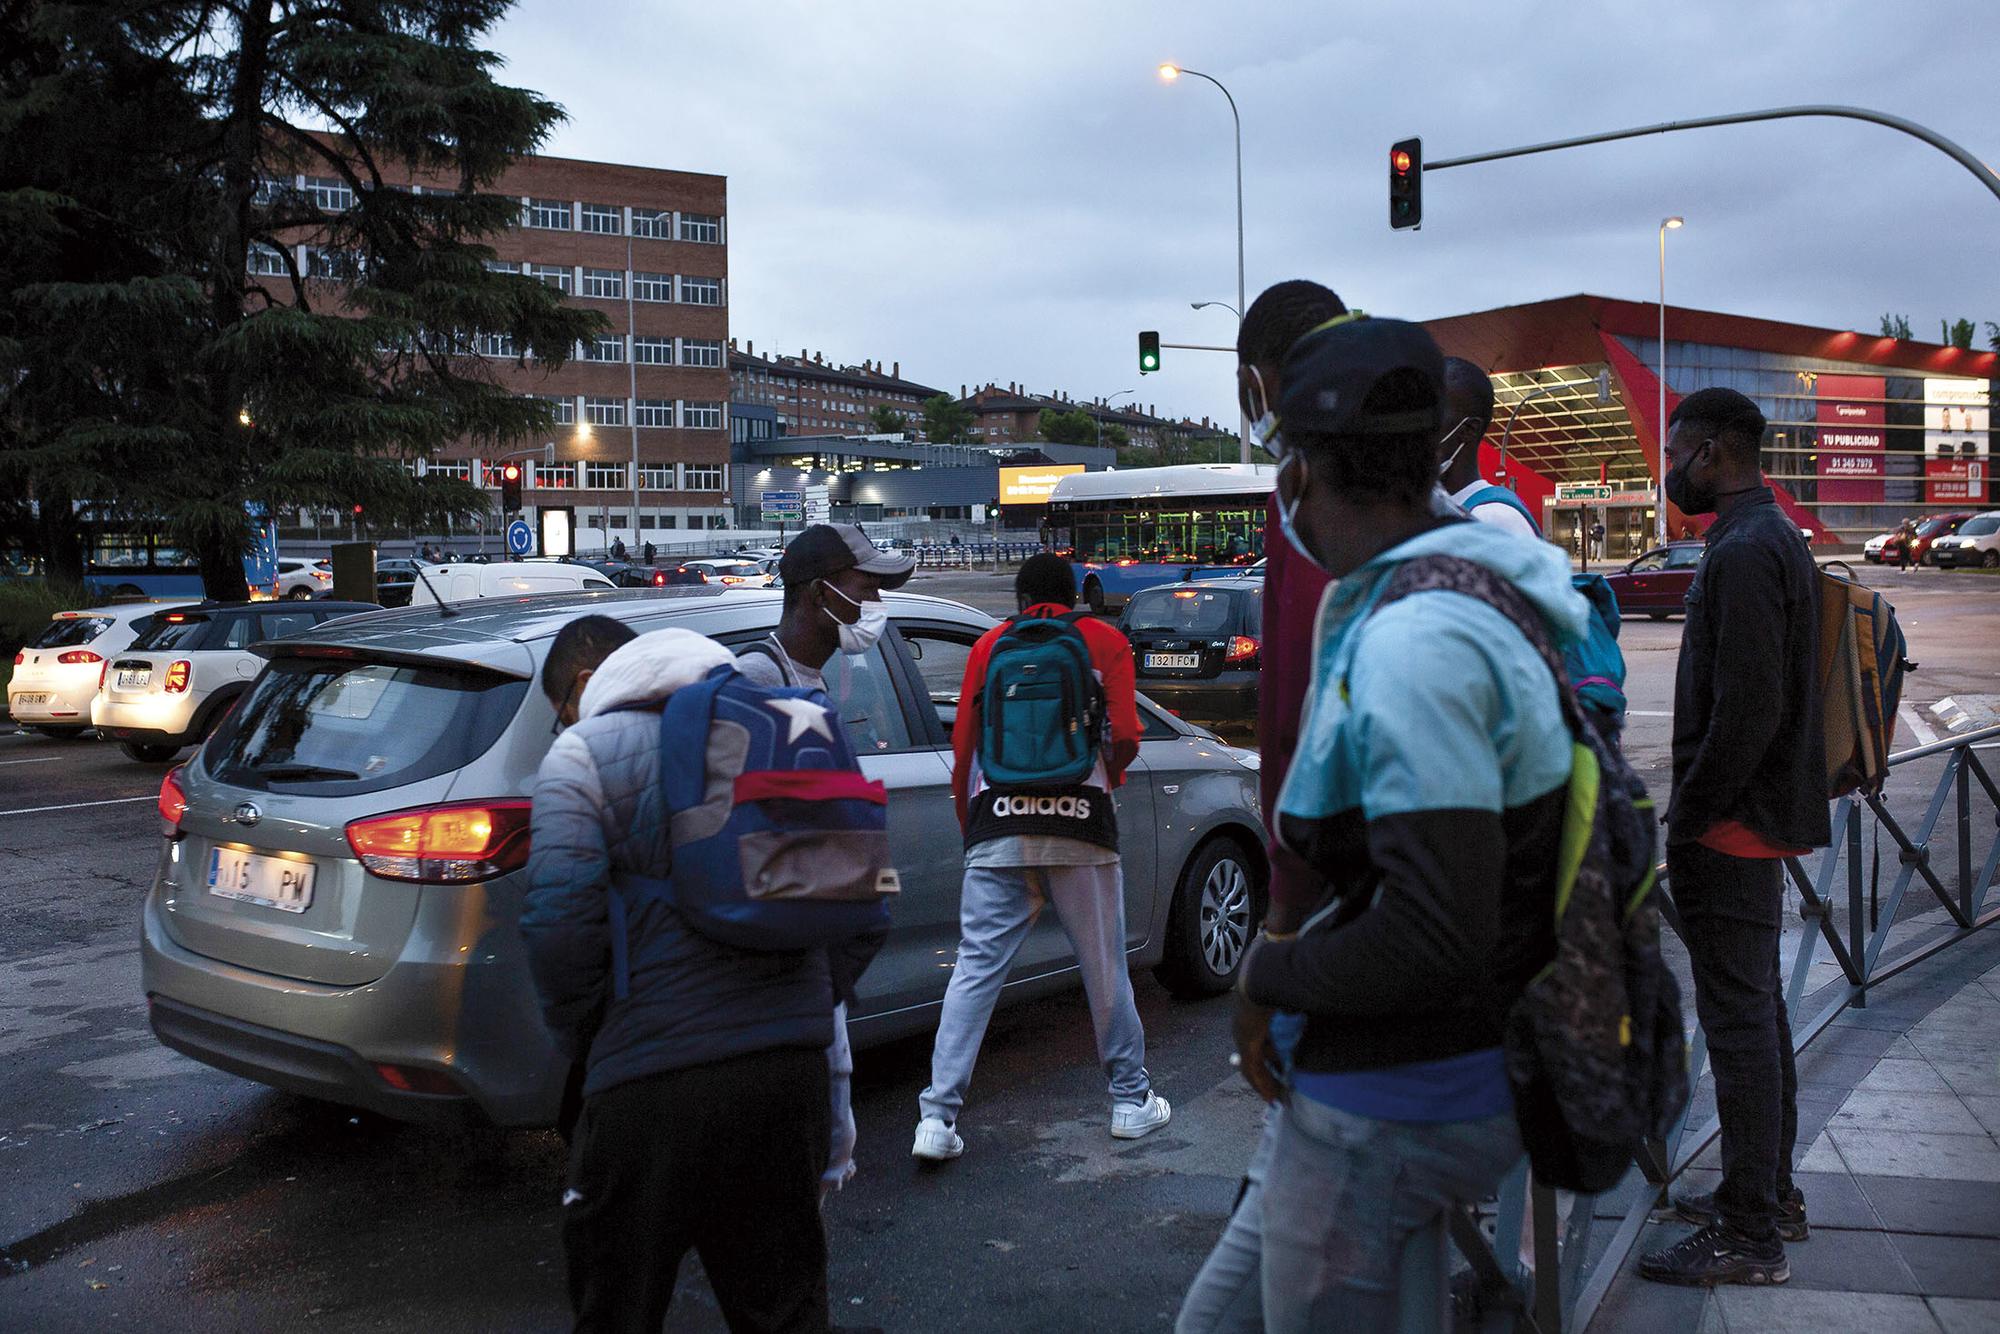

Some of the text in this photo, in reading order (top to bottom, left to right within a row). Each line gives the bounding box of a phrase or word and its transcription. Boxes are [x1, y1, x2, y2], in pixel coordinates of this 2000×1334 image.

[1823, 434, 1880, 447] TU PUBLICIDAD
[1152, 656, 1195, 666] 1321 FCW
[992, 796, 1091, 819] adidas
